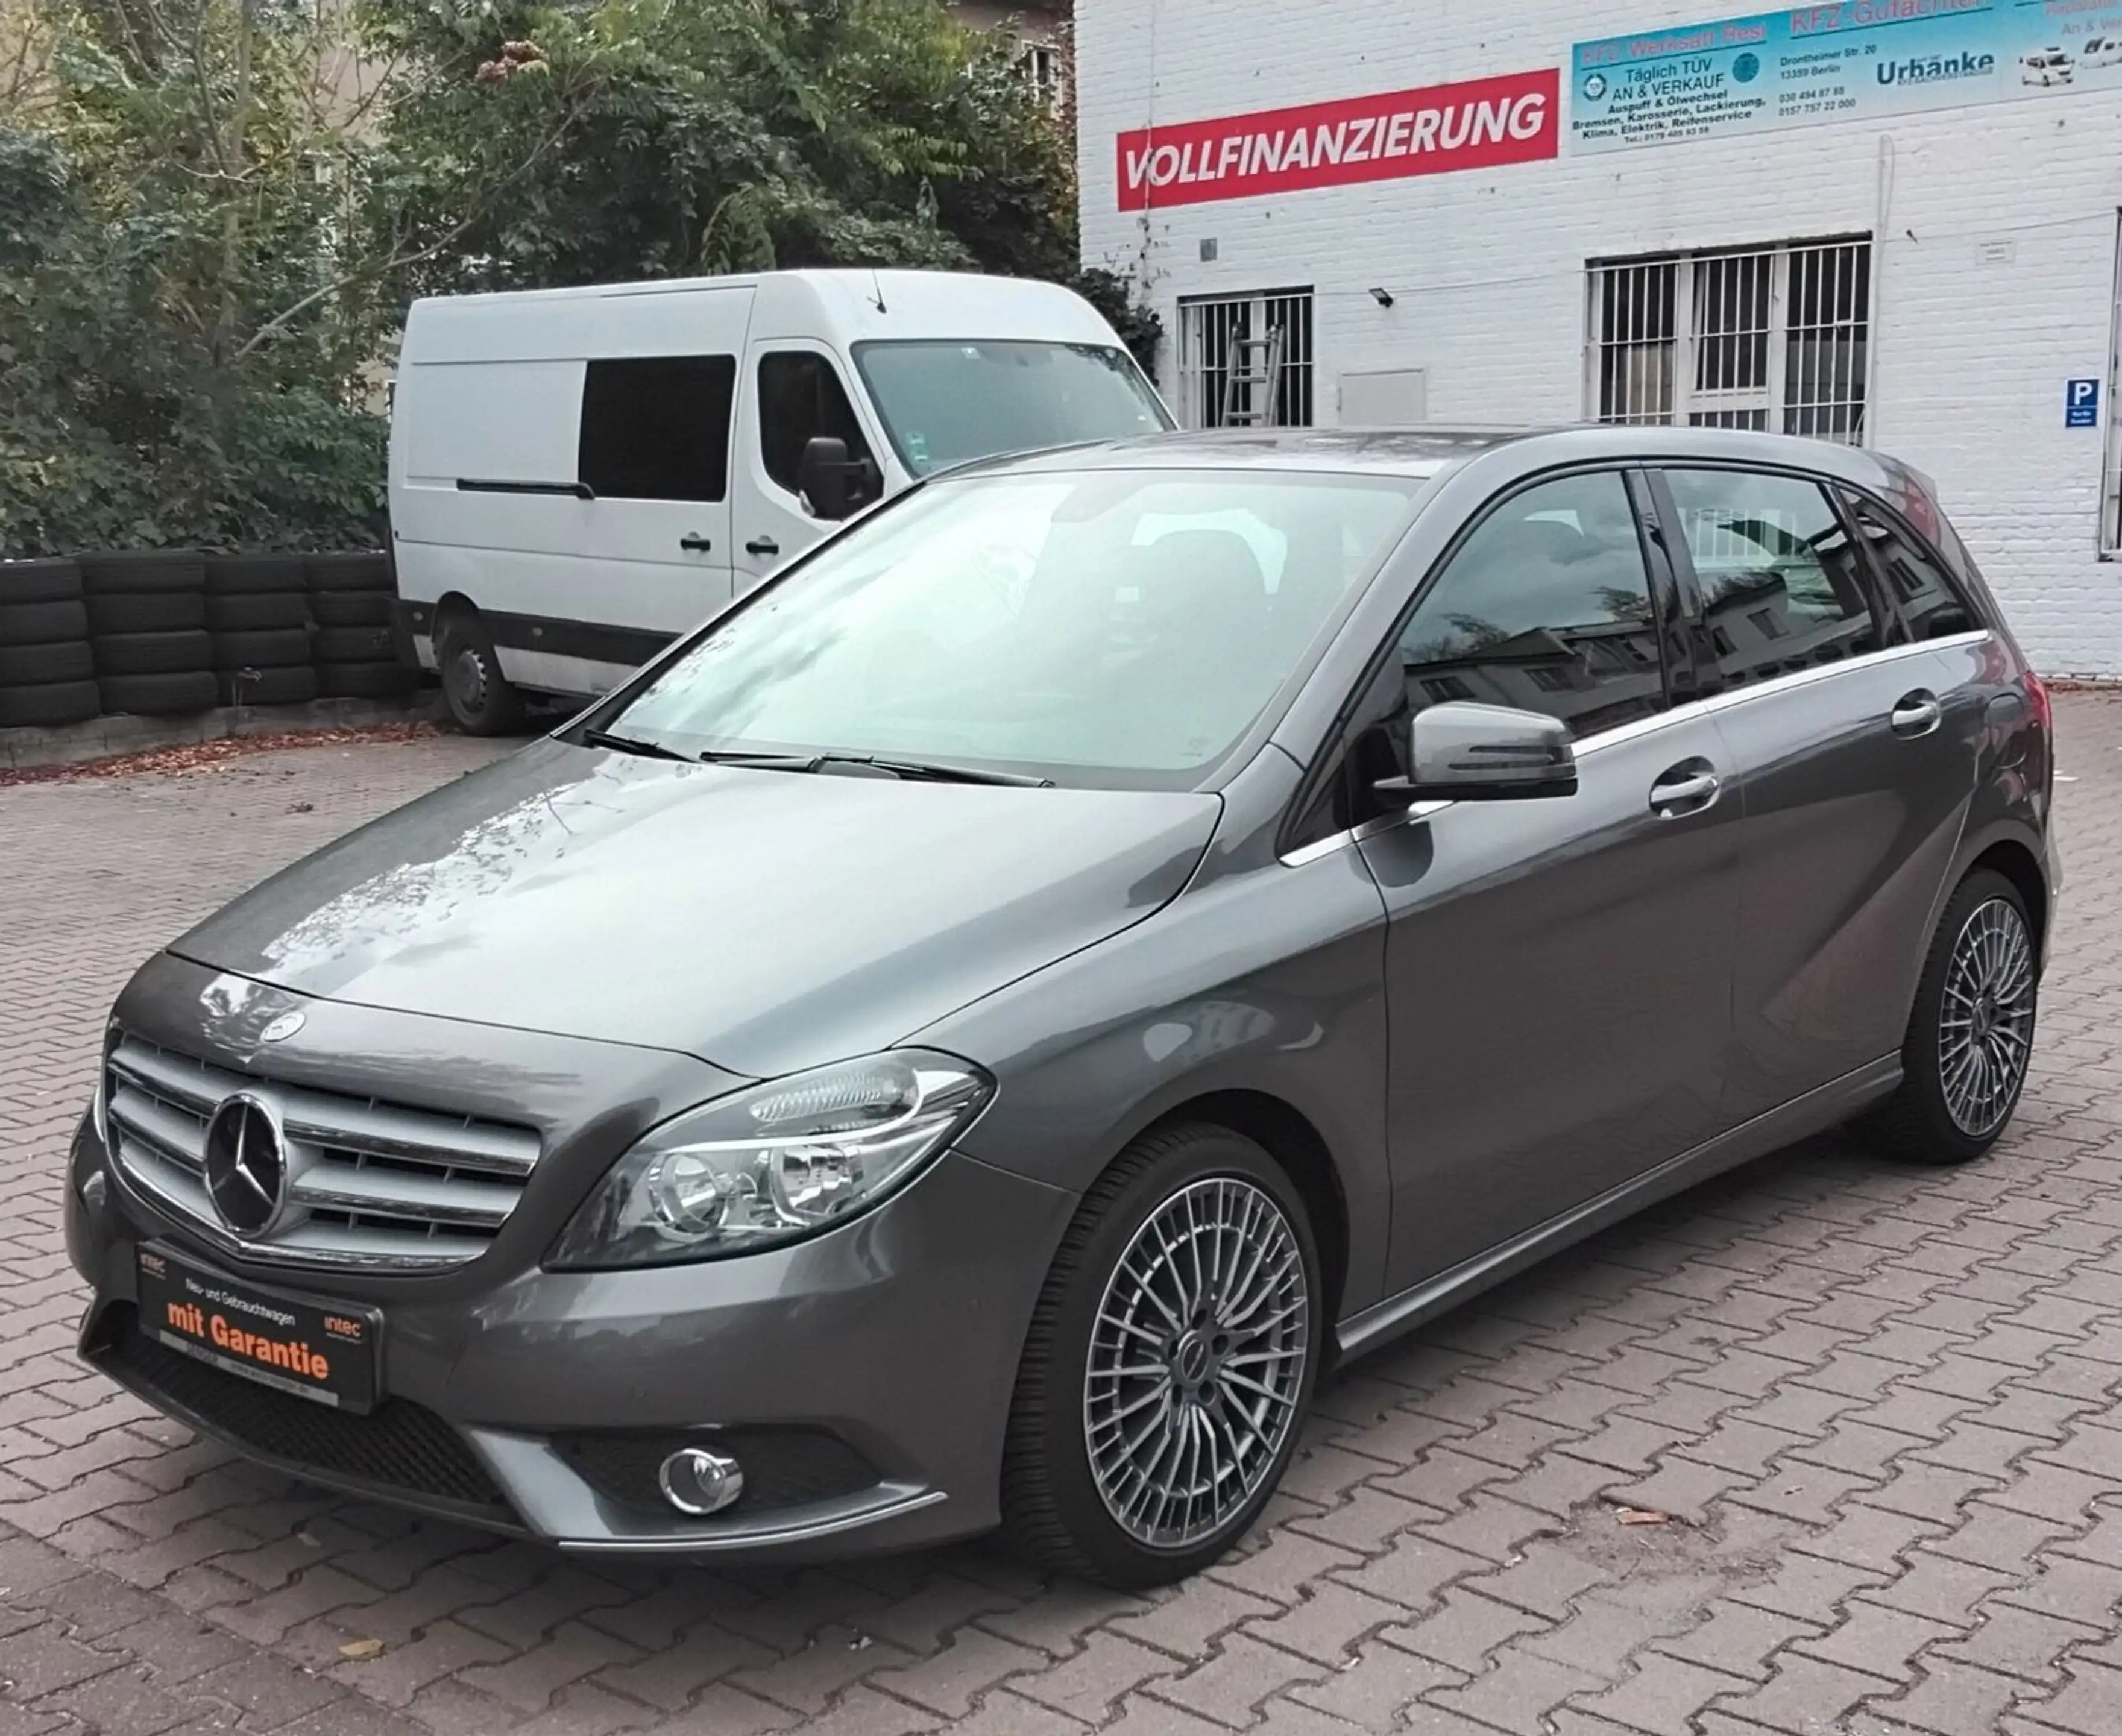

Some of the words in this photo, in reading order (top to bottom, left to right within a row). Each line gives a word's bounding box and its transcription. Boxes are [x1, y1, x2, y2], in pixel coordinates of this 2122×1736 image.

[1625, 63, 1678, 84] Täglich
[1681, 55, 1713, 75] TÜV
[1811, 64, 1841, 78] Berlin
[1611, 87, 1634, 102] AN
[1637, 84, 1648, 98] &
[1651, 72, 1725, 96] VERKAUF
[1572, 116, 1624, 131] Bremsen,
[1627, 107, 1693, 122] Karosserie,
[1696, 96, 1766, 114] Lackierung,
[1608, 99, 1652, 115] Auspuff
[1655, 98, 1664, 108] &
[1778, 104, 1801, 117] 0157
[1824, 101, 1836, 111] 22
[1837, 97, 1857, 109] 000
[1582, 128, 1619, 140] Klima,
[1620, 119, 1668, 135] Elektrik,
[1672, 109, 1752, 128] Reifenservice
[1125, 92, 1547, 189] VOLLFINANZIERUNG
[2074, 382, 2093, 406] P
[206, 1288, 221, 1303] und
[221, 1291, 296, 1327] Gebrauchtwagen
[167, 1301, 206, 1339] mit
[210, 1313, 329, 1380] Garantie
[324, 1315, 362, 1338] intec
